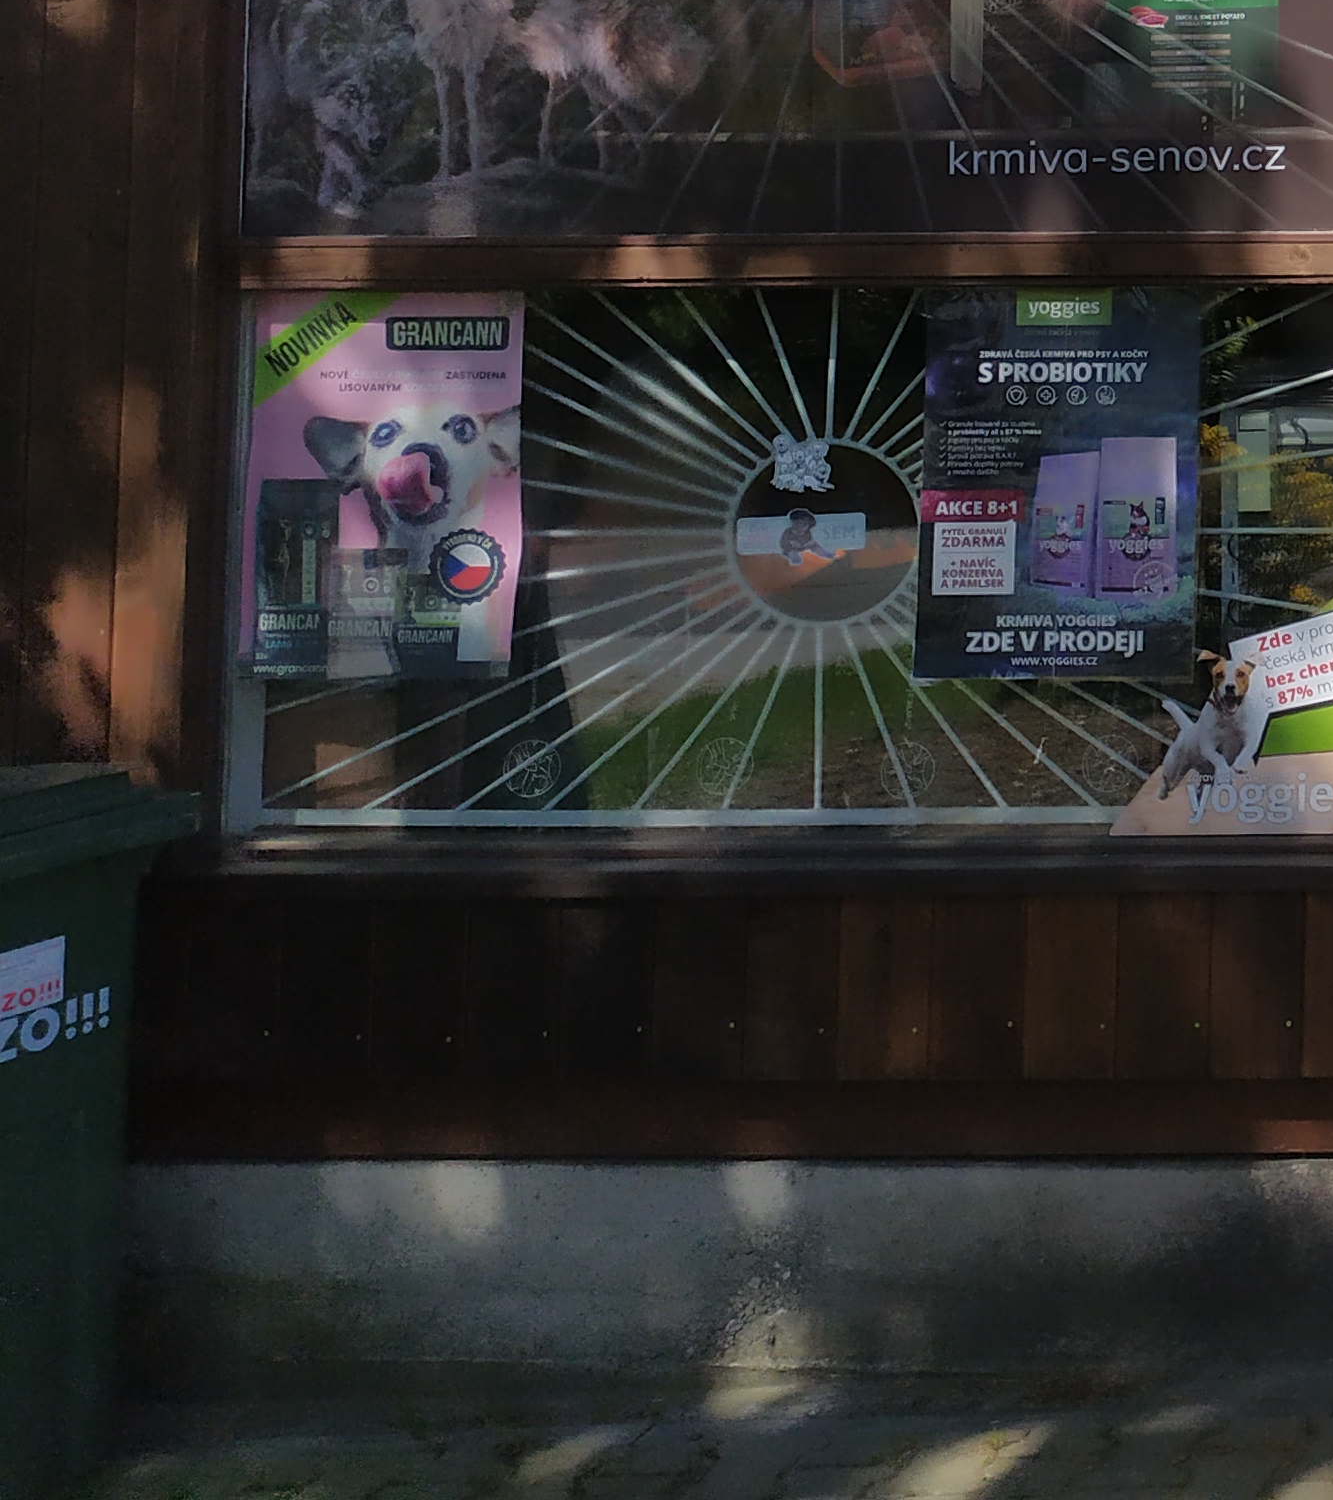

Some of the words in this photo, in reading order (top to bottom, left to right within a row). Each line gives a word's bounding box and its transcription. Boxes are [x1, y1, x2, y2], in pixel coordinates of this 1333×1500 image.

[949, 140, 1287, 176] krmiva-senov.cz
[1028, 297, 1100, 319] yoggies
[264, 300, 358, 377] NOVINKA
[393, 321, 503, 347] GRANCANN
[979, 349, 1013, 359] ZDRAVÁ
[1077, 350, 1094, 358] PRO
[1095, 350, 1111, 359] PSY
[1112, 350, 1119, 359] A
[1121, 349, 1149, 359] KOČKY
[320, 370, 349, 379] NOVÉ
[978, 362, 994, 383] S
[999, 362, 1147, 383] PROBIOTIKY
[339, 382, 401, 392] LISOVANÝM
[935, 500, 983, 516] AKCE
[987, 500, 1017, 515] 8+1
[968, 527, 1006, 535] GRANULÍ
[942, 536, 1006, 547] ZDARMA
[1109, 536, 1164, 554] yoggies
[960, 557, 995, 568] NAVÍC
[942, 569, 1004, 578] KONZERVA
[941, 579, 948, 588] A
[952, 579, 1004, 588] PAMLSEK
[996, 615, 1053, 628] KRMIVA
[1055, 615, 1117, 627] YOGGIES
[966, 631, 1015, 653] ZDE
[1019, 631, 1039, 652] V
[1044, 630, 1144, 658] PRODEJI
[1257, 631, 1293, 652] Zde
[1295, 632, 1306, 642] v
[1011, 656, 1099, 666] WWW.YOGGIES.CZ
[1265, 650, 1306, 670] česká
[1265, 668, 1295, 689] bez
[1266, 698, 1274, 708] s
[1277, 684, 1313, 705] 87%
